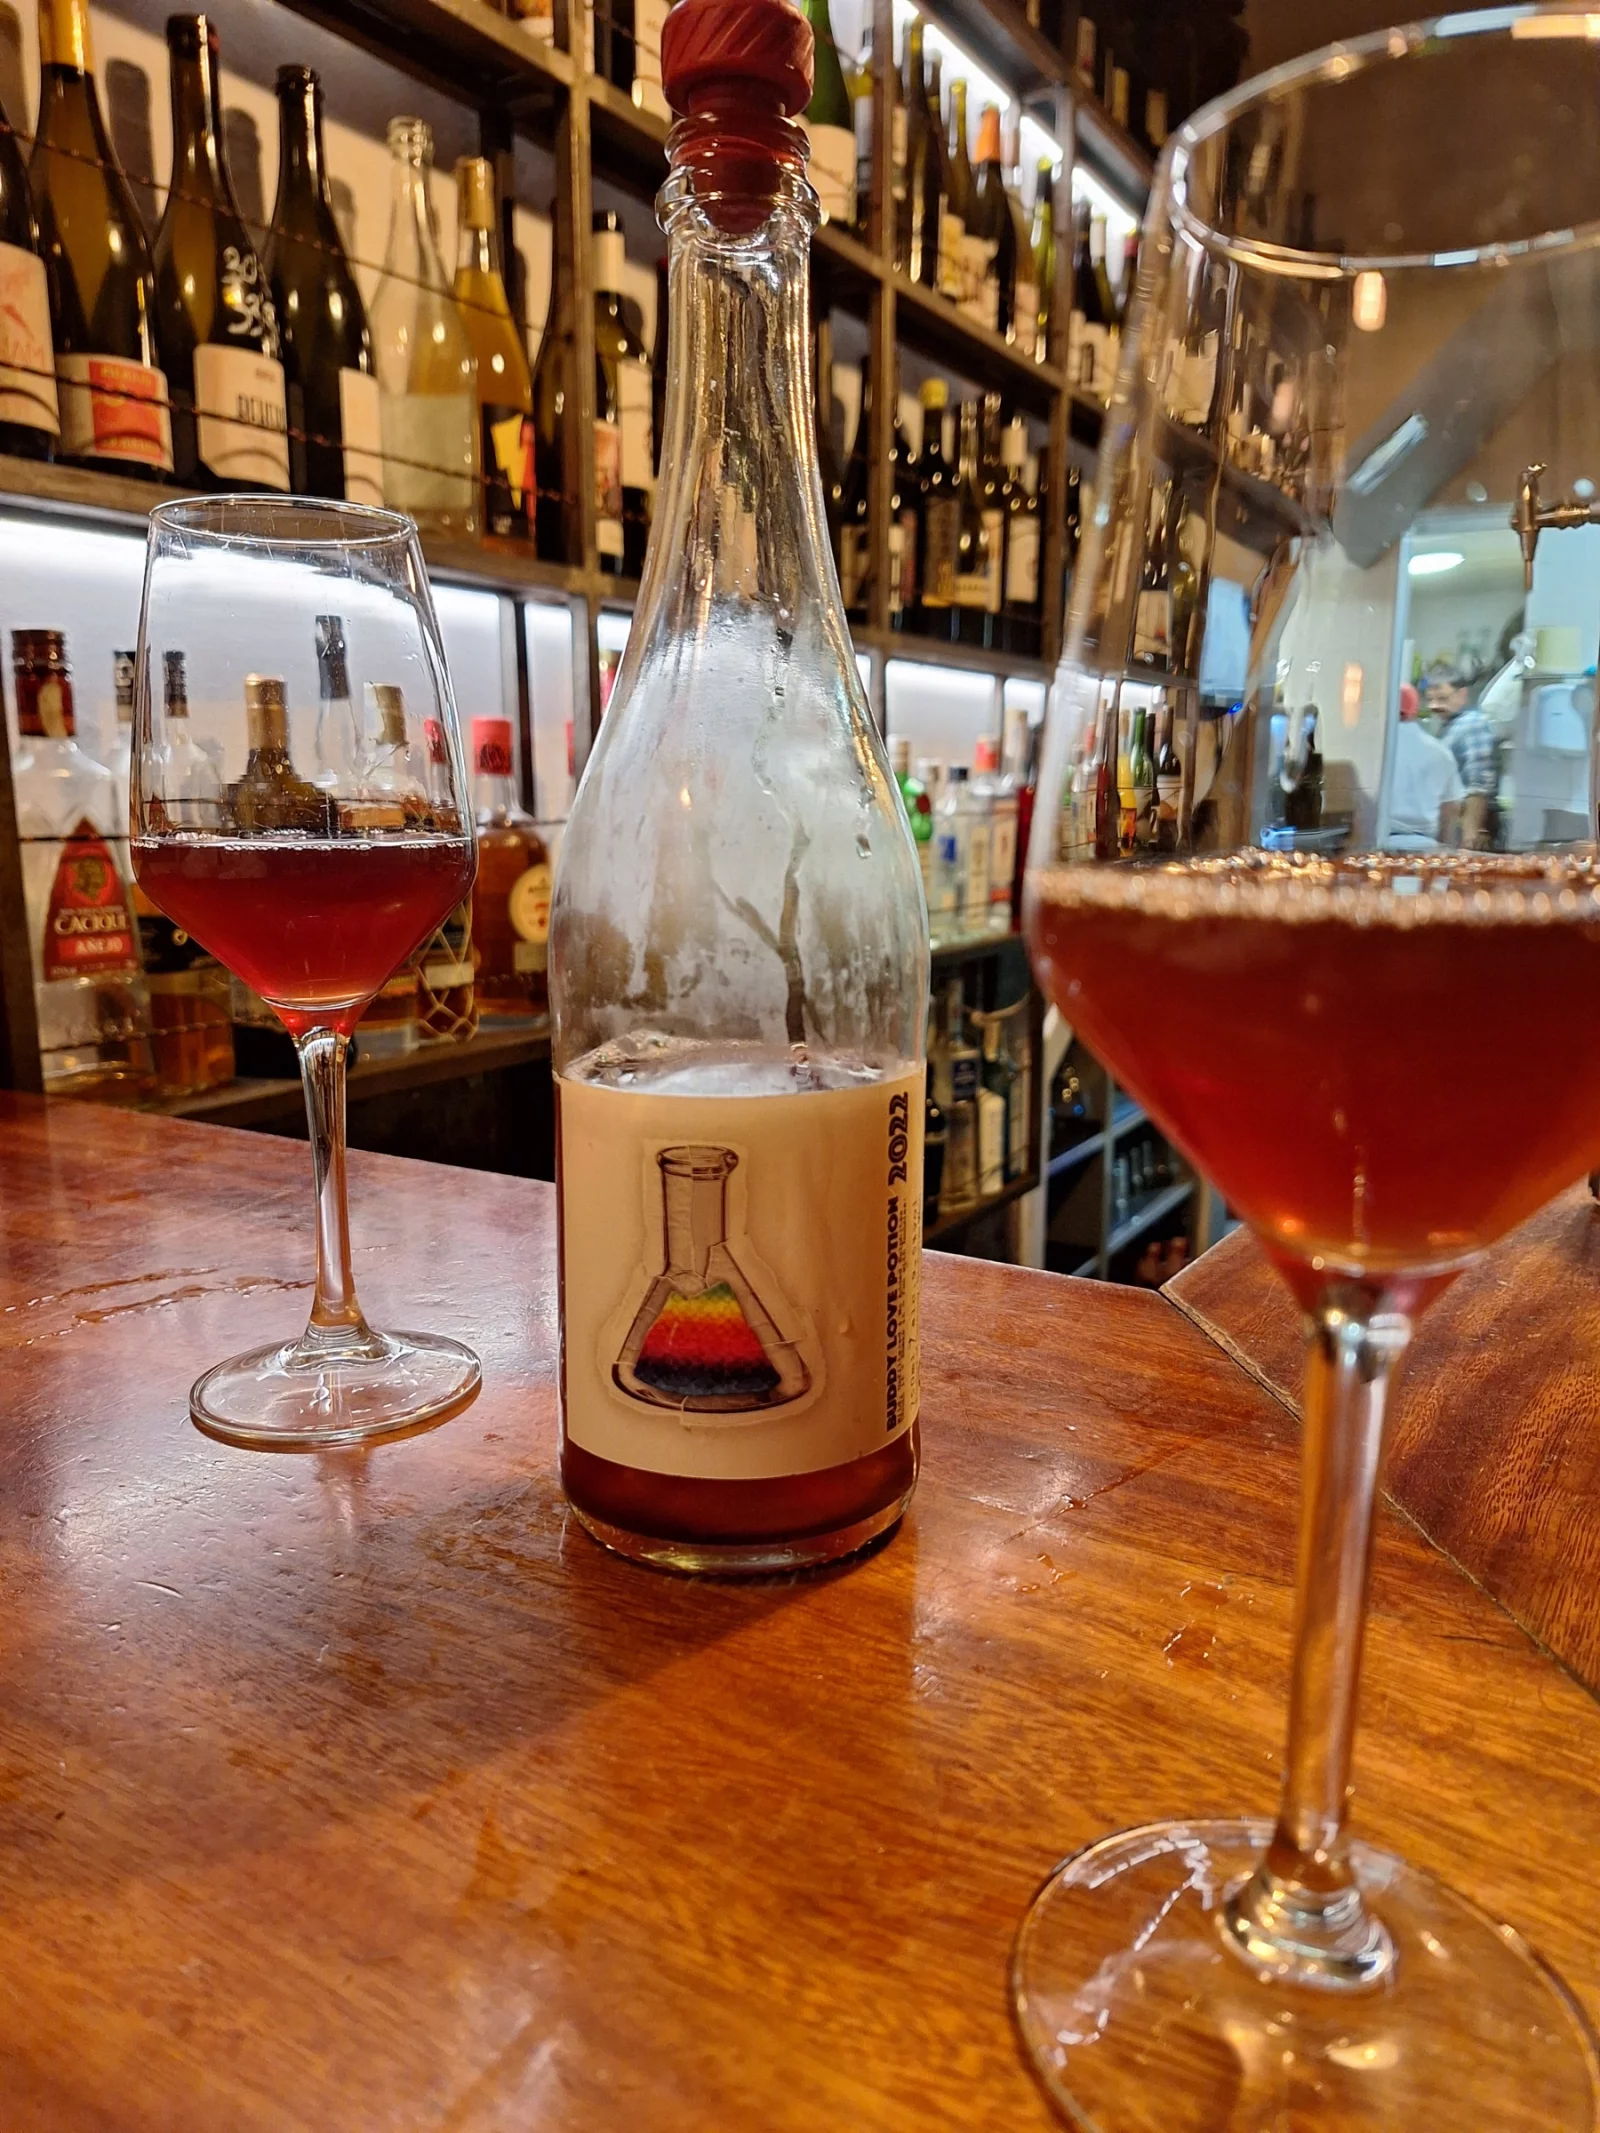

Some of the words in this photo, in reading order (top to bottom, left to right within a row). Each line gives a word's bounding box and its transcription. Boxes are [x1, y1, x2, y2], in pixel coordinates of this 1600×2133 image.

[888, 1091, 908, 1187] 2022
[887, 1195, 899, 1288] POTION
[887, 1289, 898, 1351] LOVE
[886, 1354, 897, 1432] BUDDY
